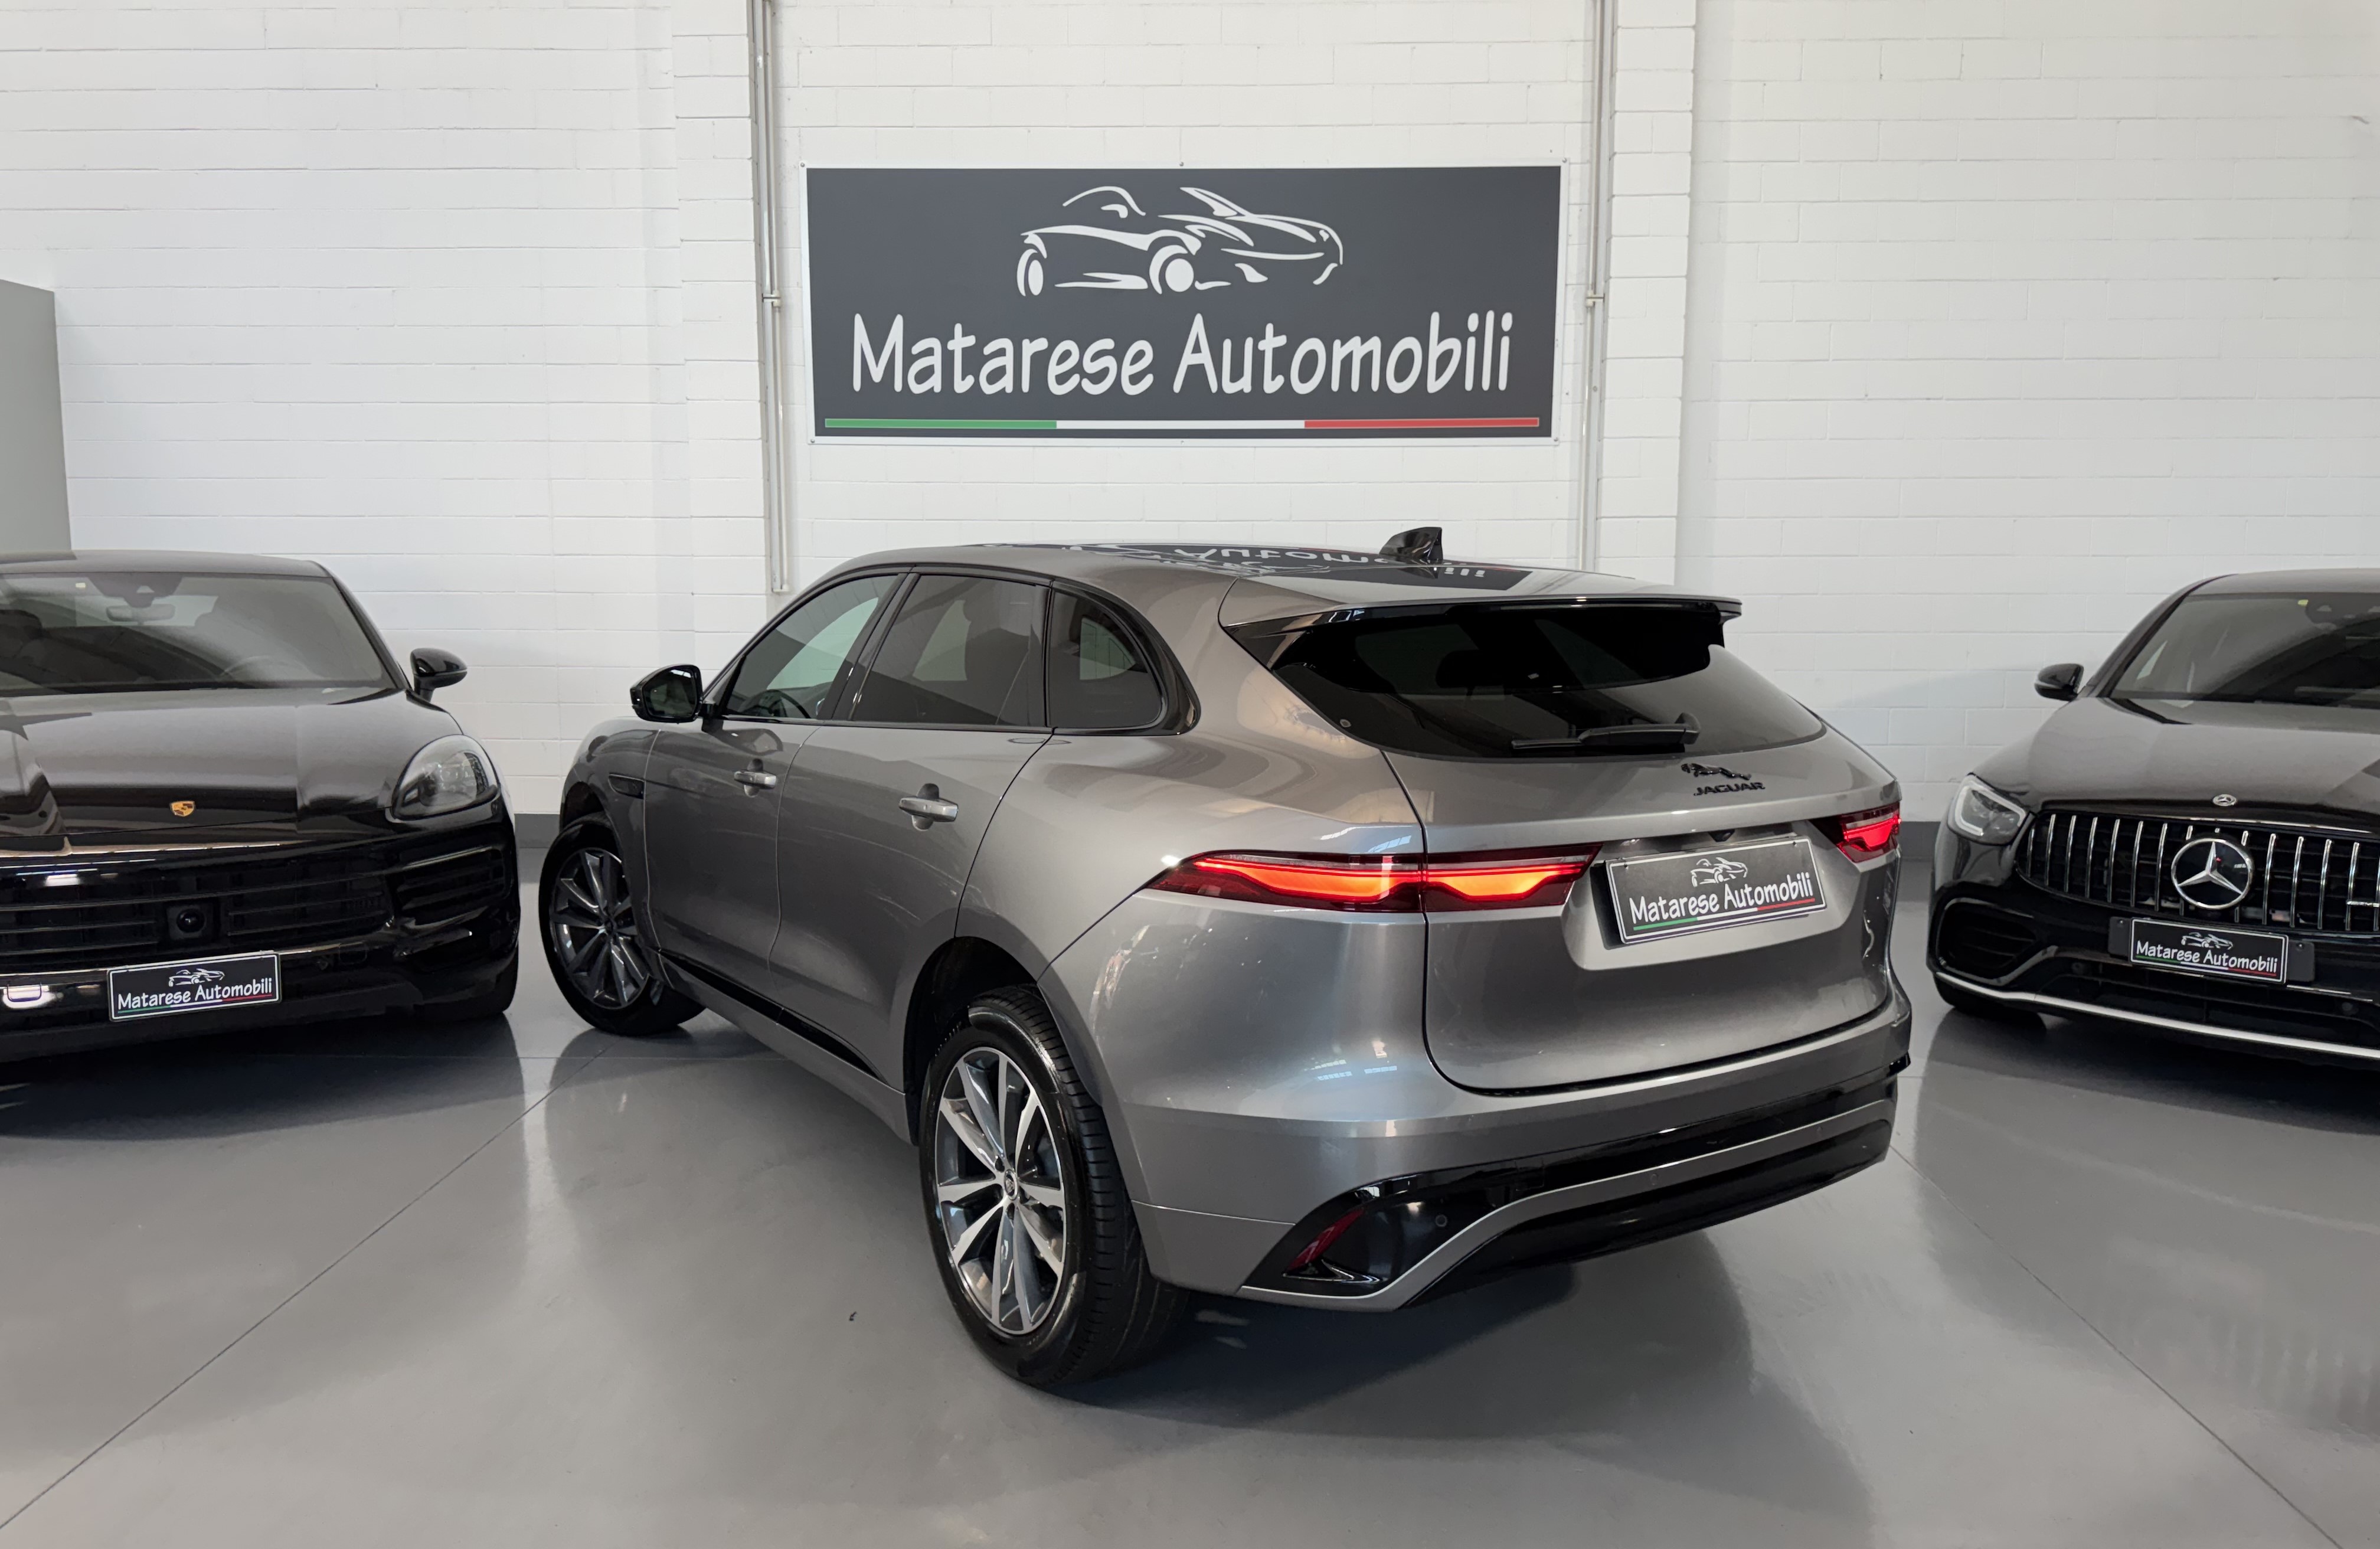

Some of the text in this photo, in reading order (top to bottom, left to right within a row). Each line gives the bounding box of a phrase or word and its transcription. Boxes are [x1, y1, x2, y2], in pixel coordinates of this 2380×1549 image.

[852, 310, 1513, 396] Matarese Automobili
[1694, 782, 1766, 796] JAGUAR
[1629, 872, 1813, 924] Matarese Automobili
[2136, 940, 2278, 973] Matarese Automobili
[117, 977, 272, 1010] Matarese Automobili
